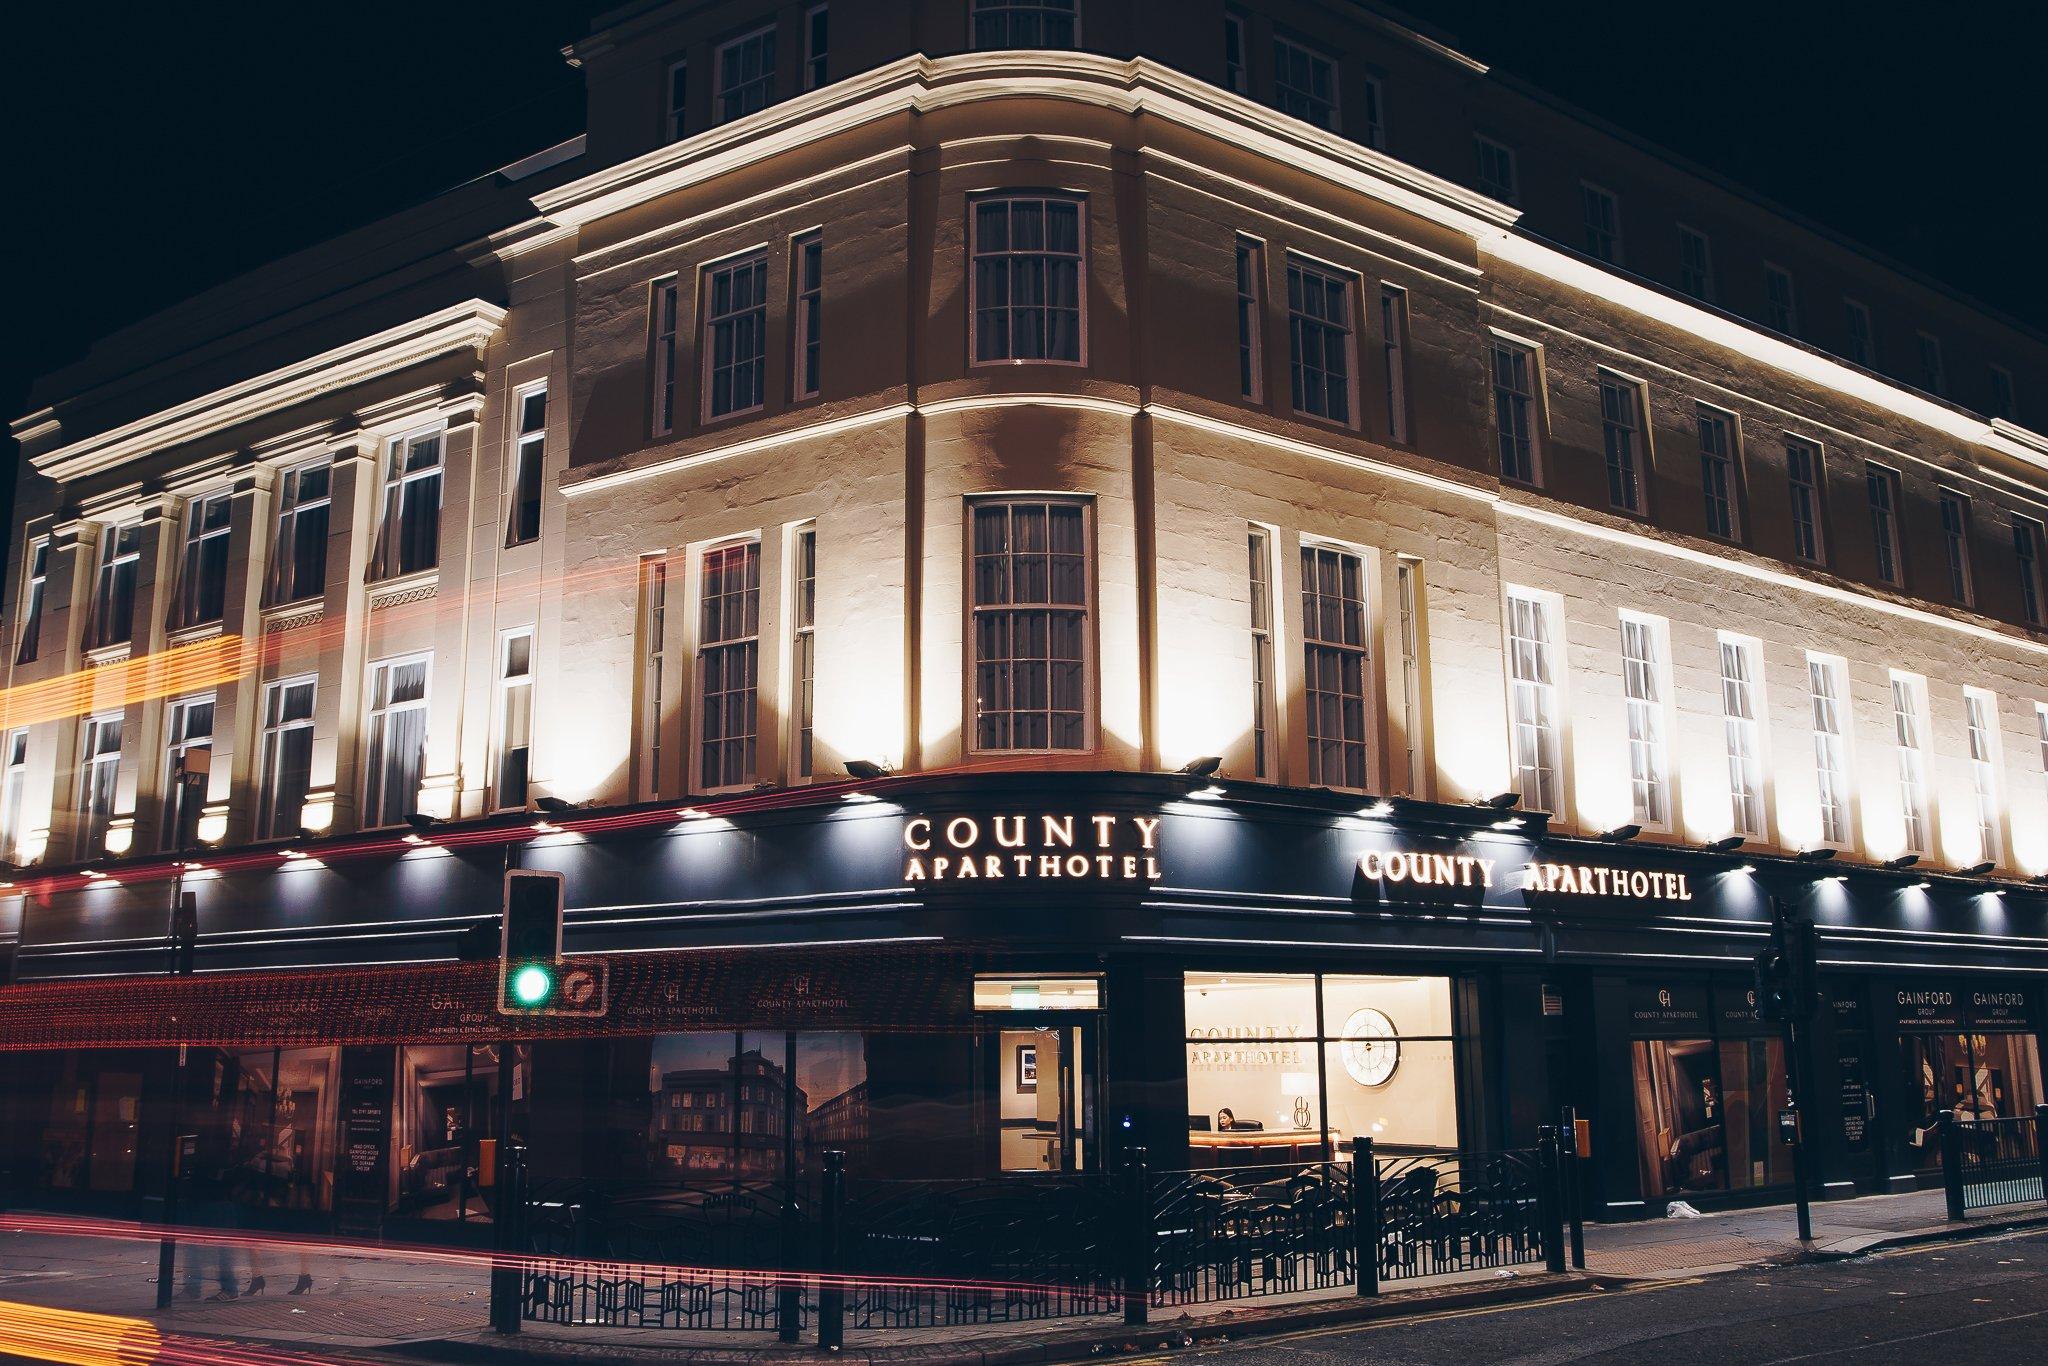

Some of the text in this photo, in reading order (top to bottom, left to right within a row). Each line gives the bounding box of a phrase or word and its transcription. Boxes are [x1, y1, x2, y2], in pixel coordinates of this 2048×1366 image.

[904, 816, 1161, 850] COUNTY
[904, 855, 1162, 881] APARTHOTEL
[1359, 849, 1692, 900] COUNTY APARTHOTEL
[757, 999, 849, 1008] COUNTY APARTHOTEL
[1898, 991, 1952, 1005] GAINFORD
[1973, 992, 2024, 1006] GAINFORD
[627, 1006, 720, 1015] COUNTY APARTHOTEL
[1634, 1011, 1699, 1019] COUNTY APARTHOTEL
[1725, 1011, 1748, 1019] COUNTY
[1917, 1008, 1935, 1016] GROUP
[1190, 1026, 1298, 1046] COUNTY
[1191, 1051, 1302, 1064] APARTHOTEL
